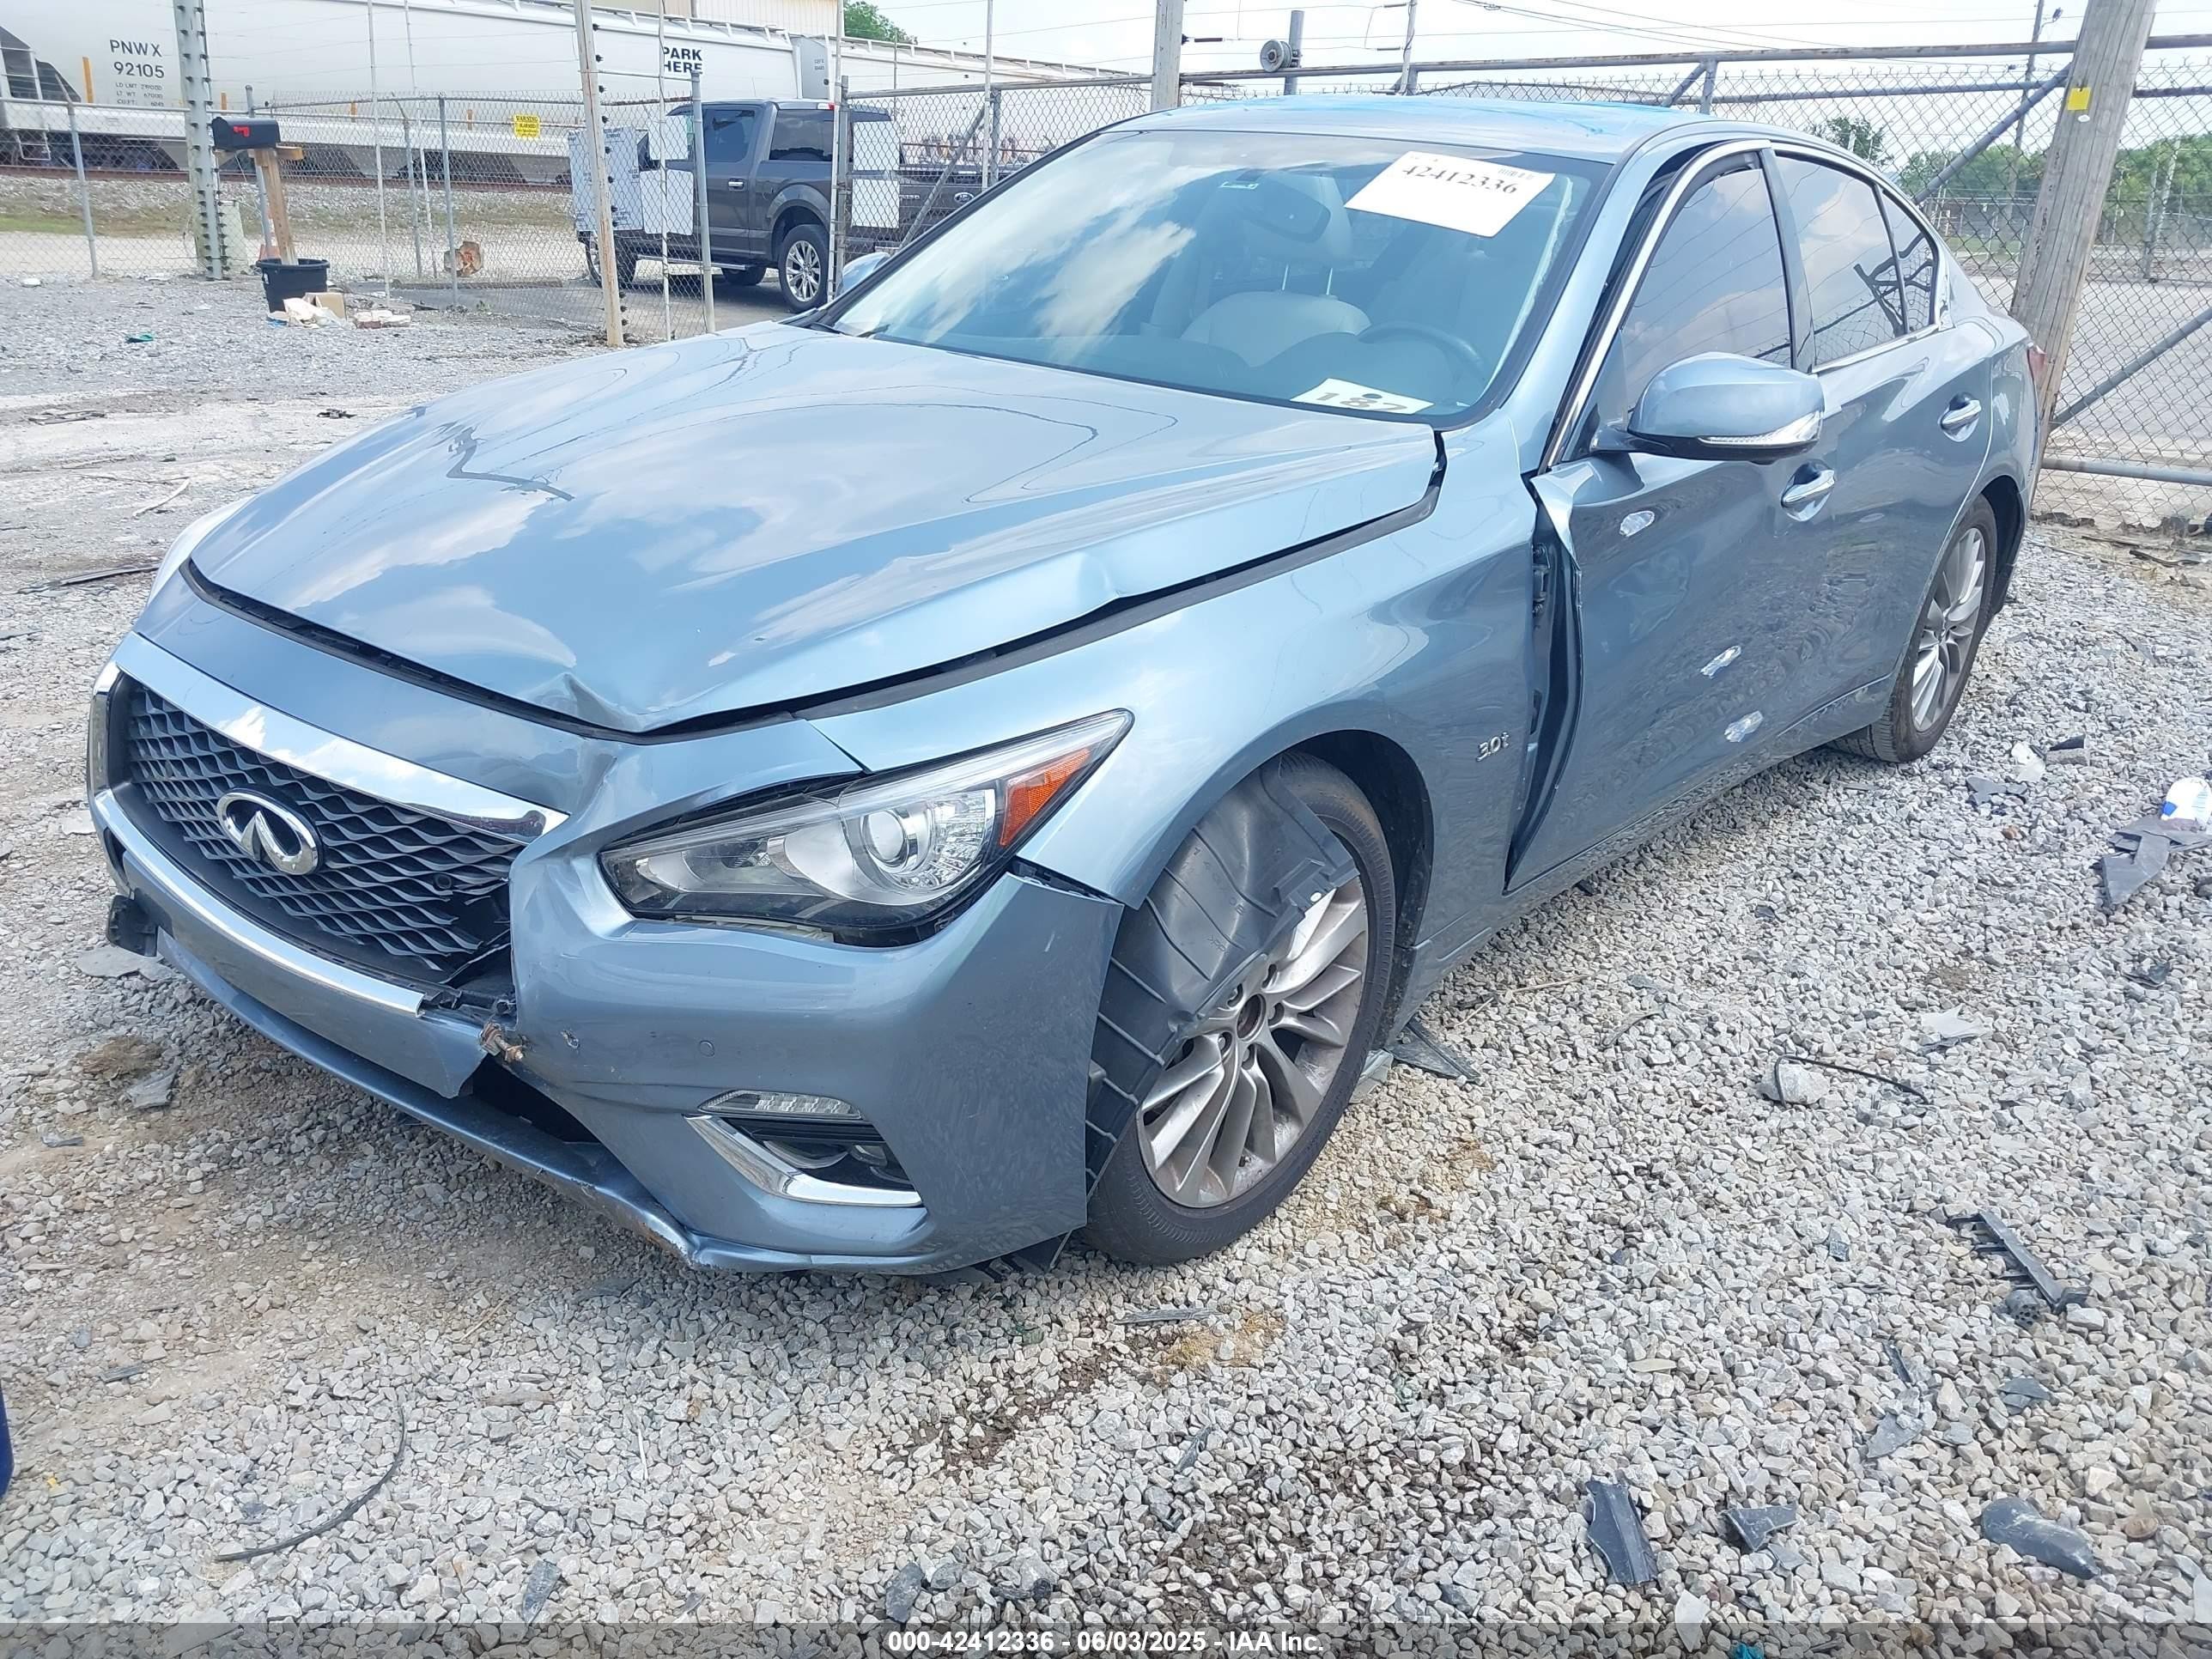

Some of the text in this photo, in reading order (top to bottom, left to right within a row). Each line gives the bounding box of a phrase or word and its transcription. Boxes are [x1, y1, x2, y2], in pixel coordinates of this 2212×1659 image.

[110, 40, 162, 58] PNWX
[664, 46, 702, 61] PARK
[113, 61, 164, 78] 92105
[664, 61, 703, 75] HERE
[1402, 165, 1518, 194] 42412336
